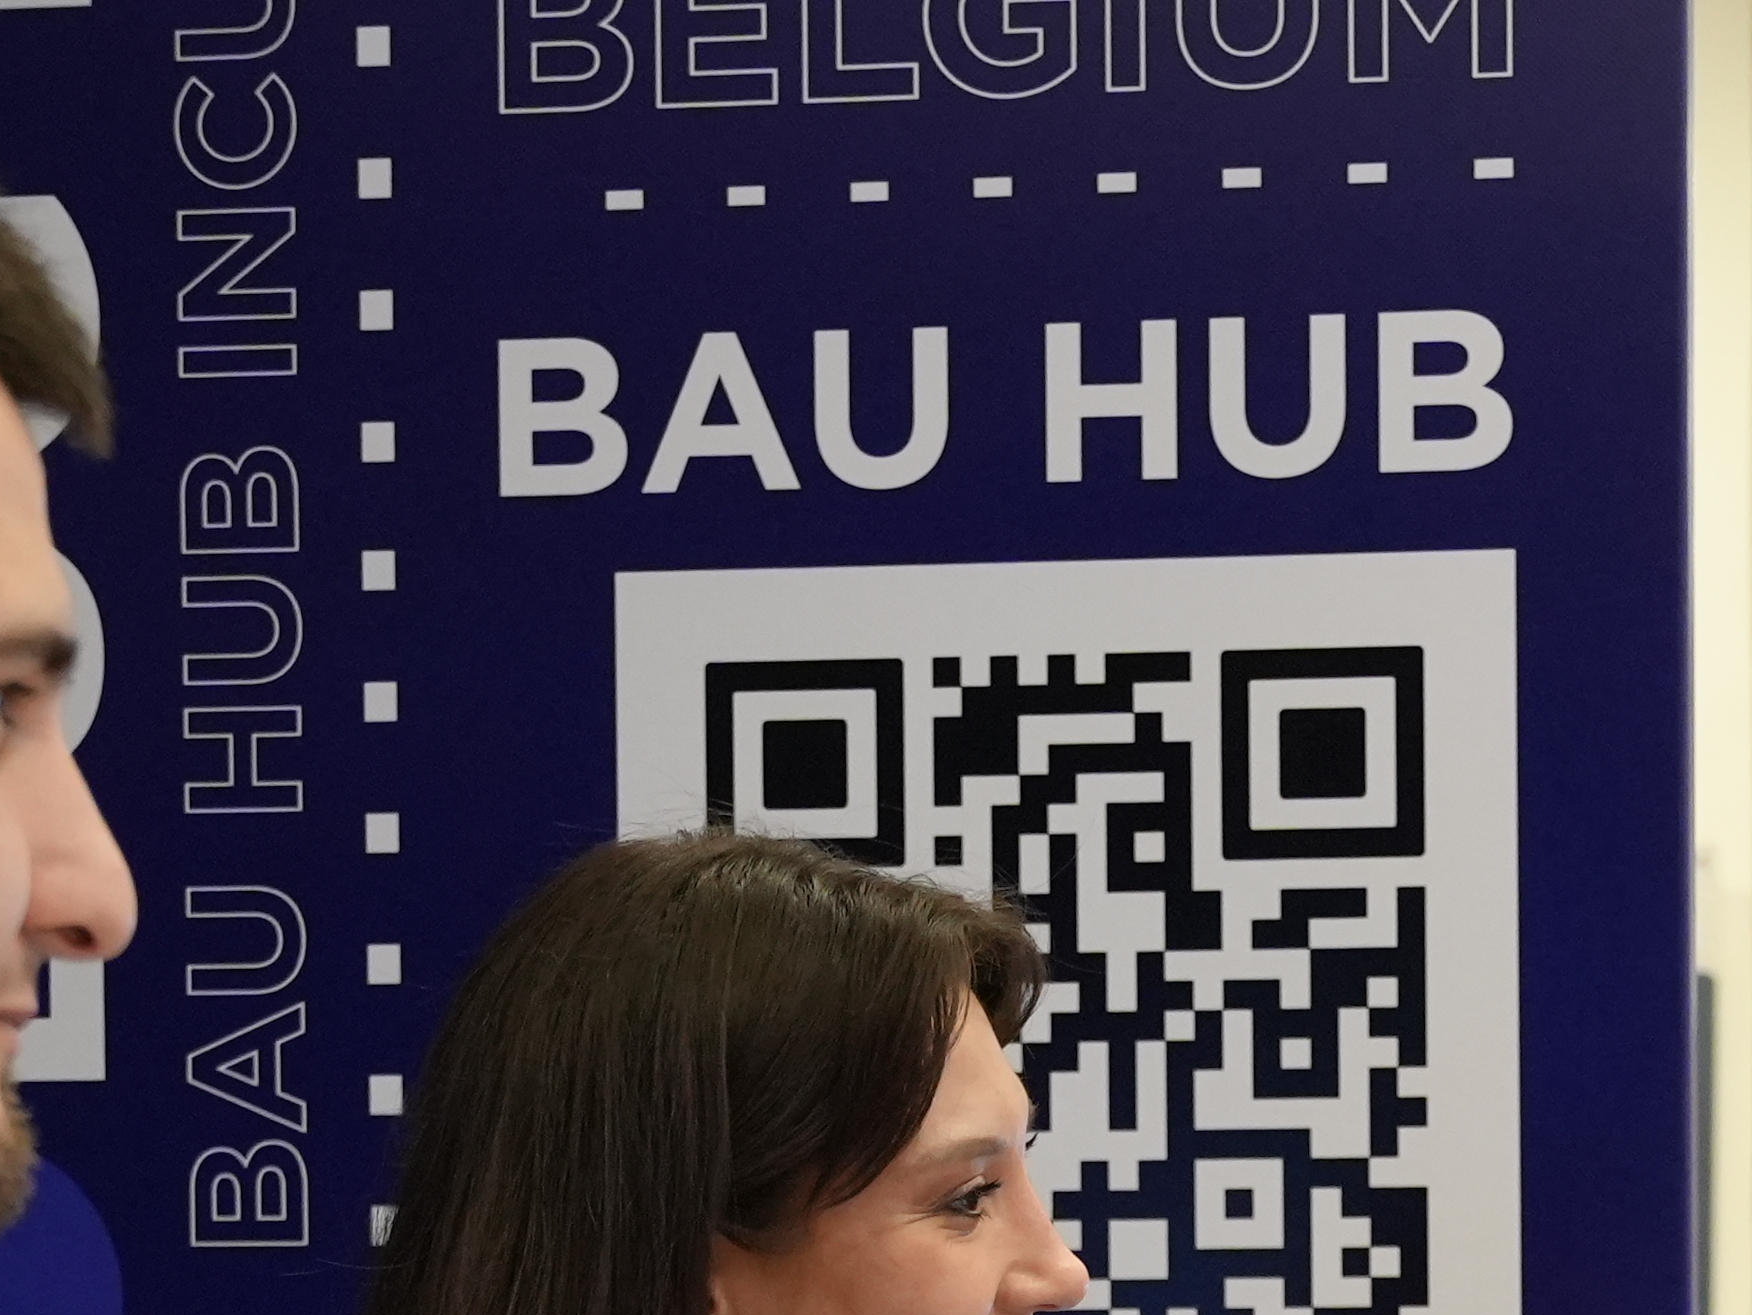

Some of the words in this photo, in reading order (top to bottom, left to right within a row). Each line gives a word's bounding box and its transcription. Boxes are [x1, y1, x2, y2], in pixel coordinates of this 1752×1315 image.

[497, 326, 950, 498] BAU
[1044, 308, 1515, 483] HUB
[180, 445, 304, 813] HUB
[186, 885, 310, 1249] BAU
